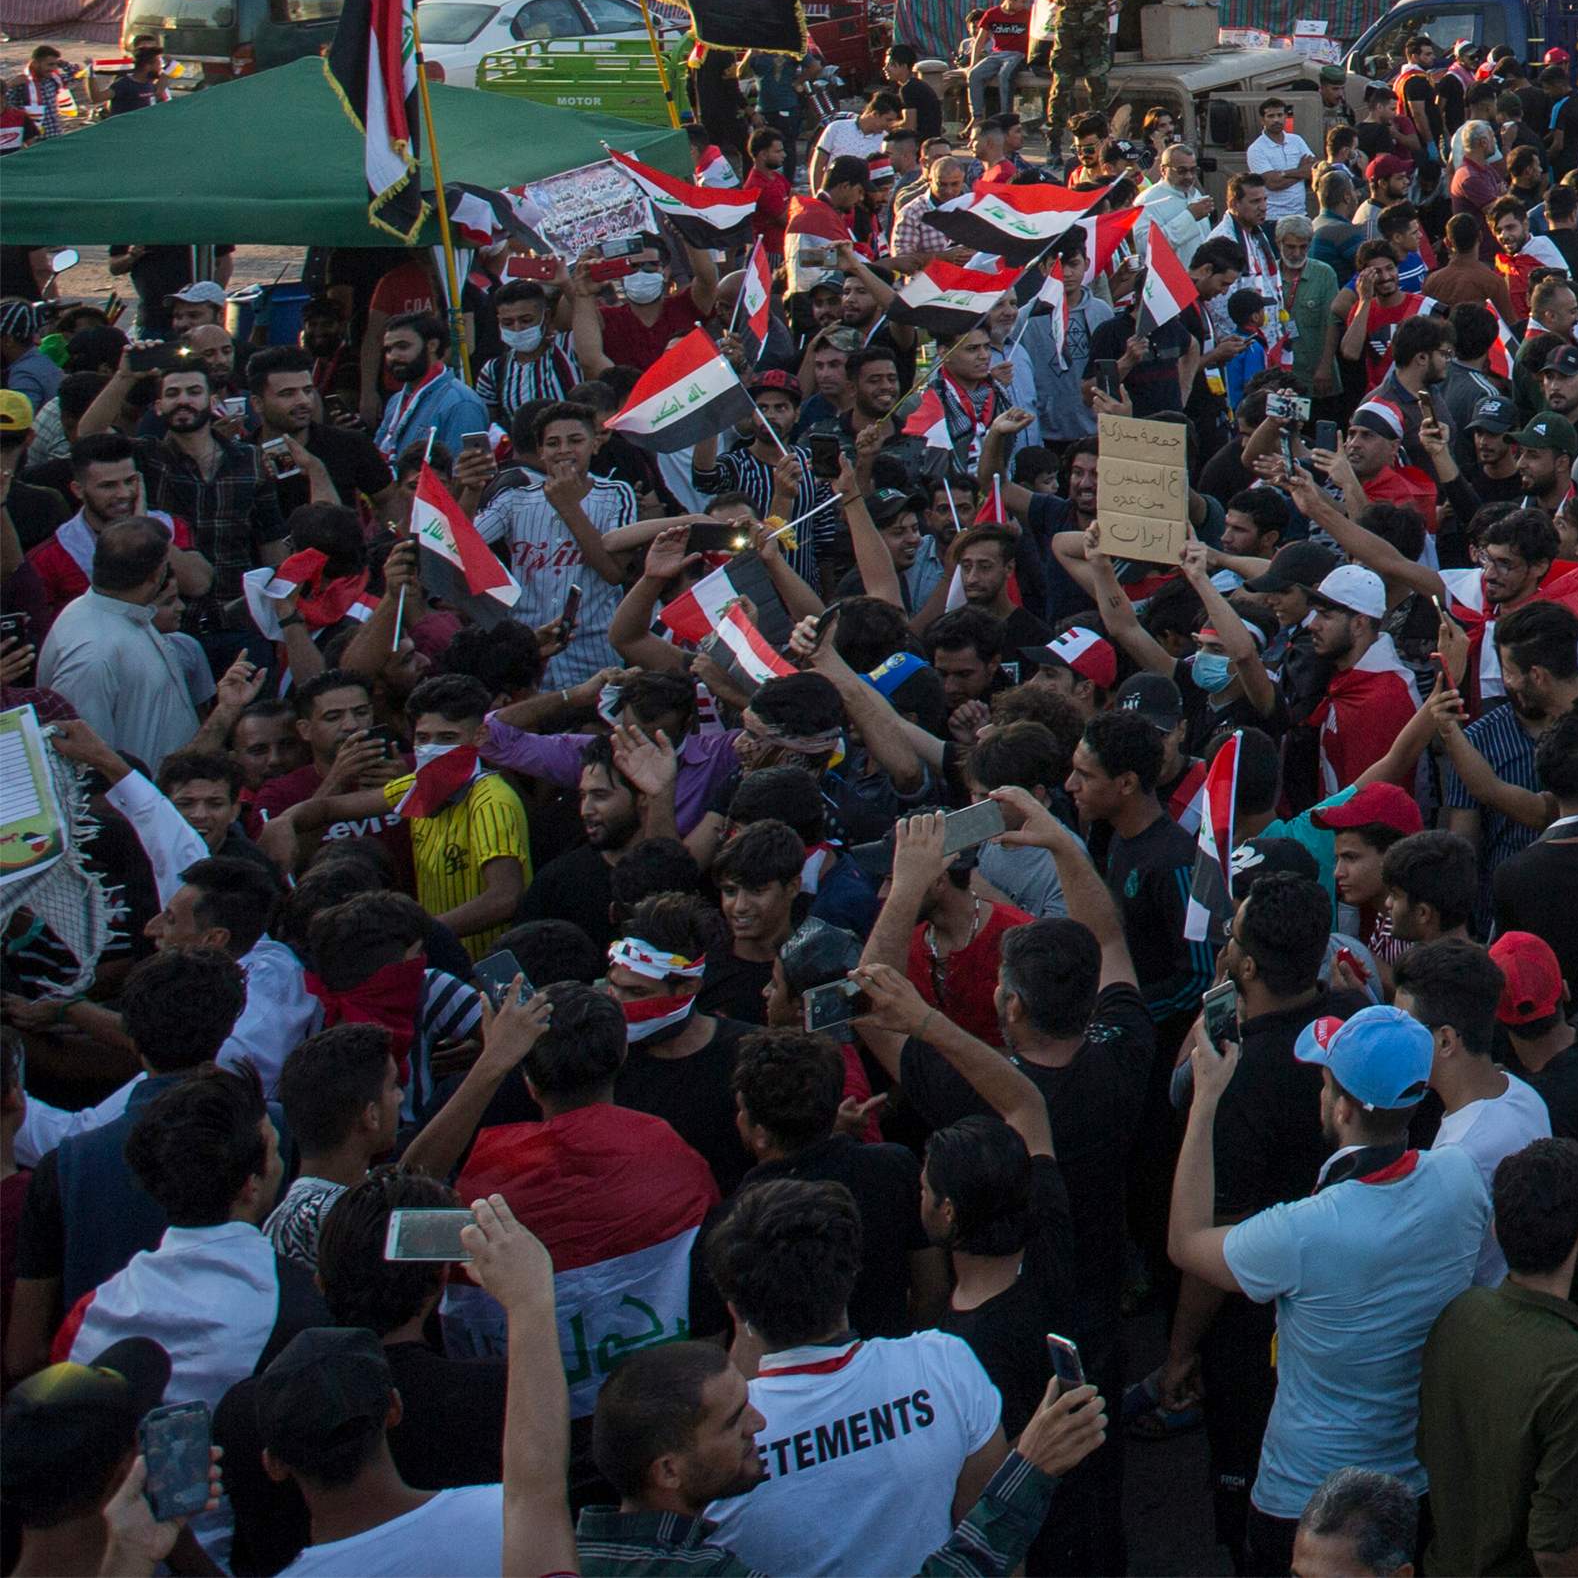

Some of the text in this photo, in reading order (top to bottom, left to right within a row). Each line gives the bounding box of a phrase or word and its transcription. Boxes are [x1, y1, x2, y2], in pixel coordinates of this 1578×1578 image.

[557, 96, 602, 107] MOTOR
[511, 539, 587, 582] Twin
[321, 812, 401, 841] evis
[756, 1388, 935, 1486] ETEMENTS
